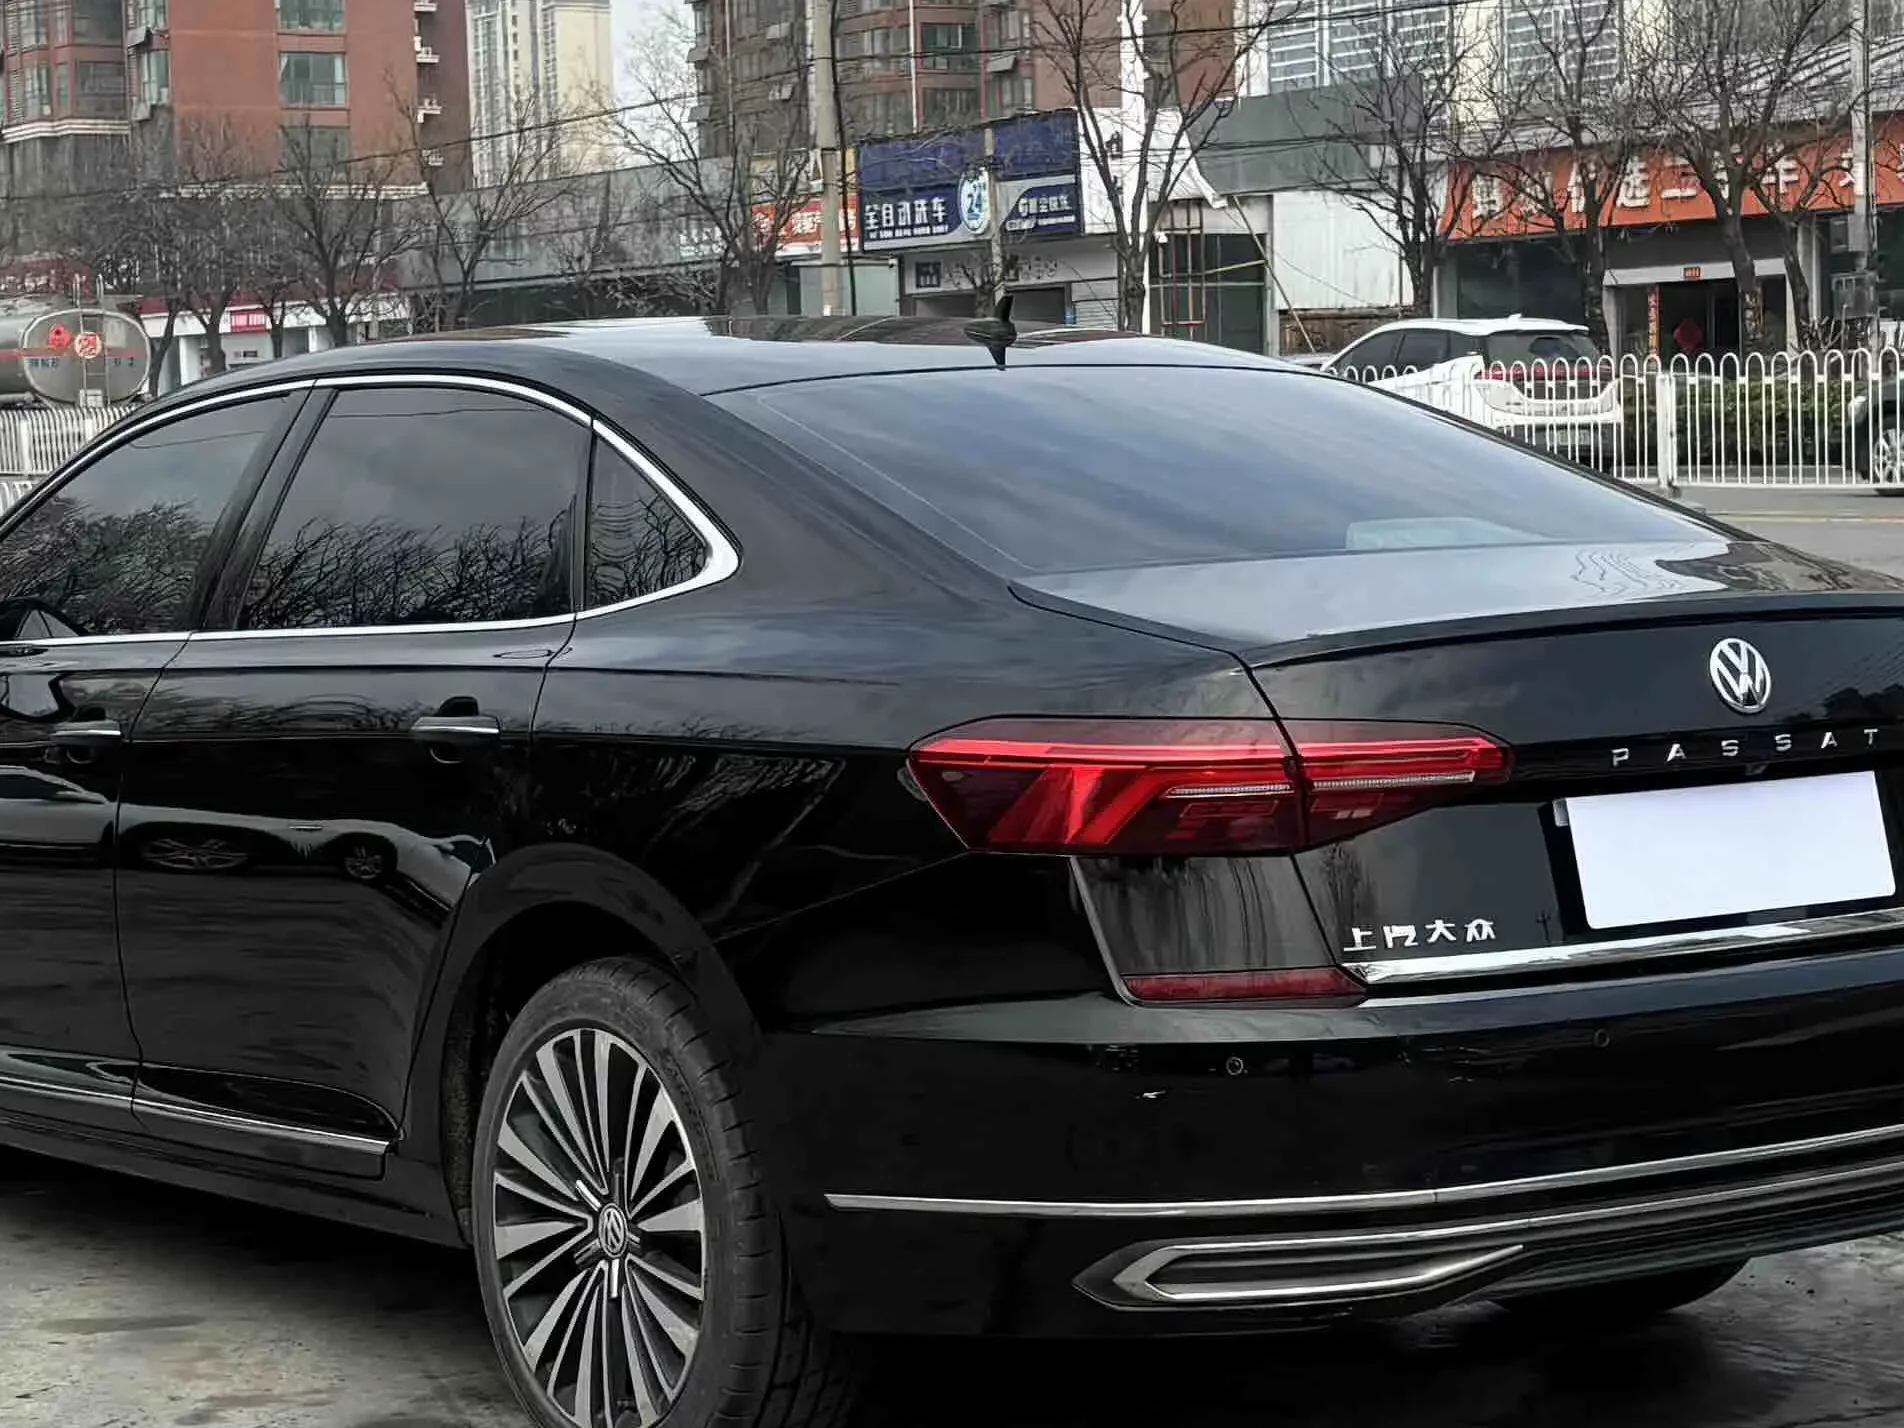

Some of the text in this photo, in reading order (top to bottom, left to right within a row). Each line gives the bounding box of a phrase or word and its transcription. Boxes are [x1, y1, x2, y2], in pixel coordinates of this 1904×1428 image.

[1612, 728, 1878, 767] PASSAT
[1343, 918, 1496, 952] 上汽大众
